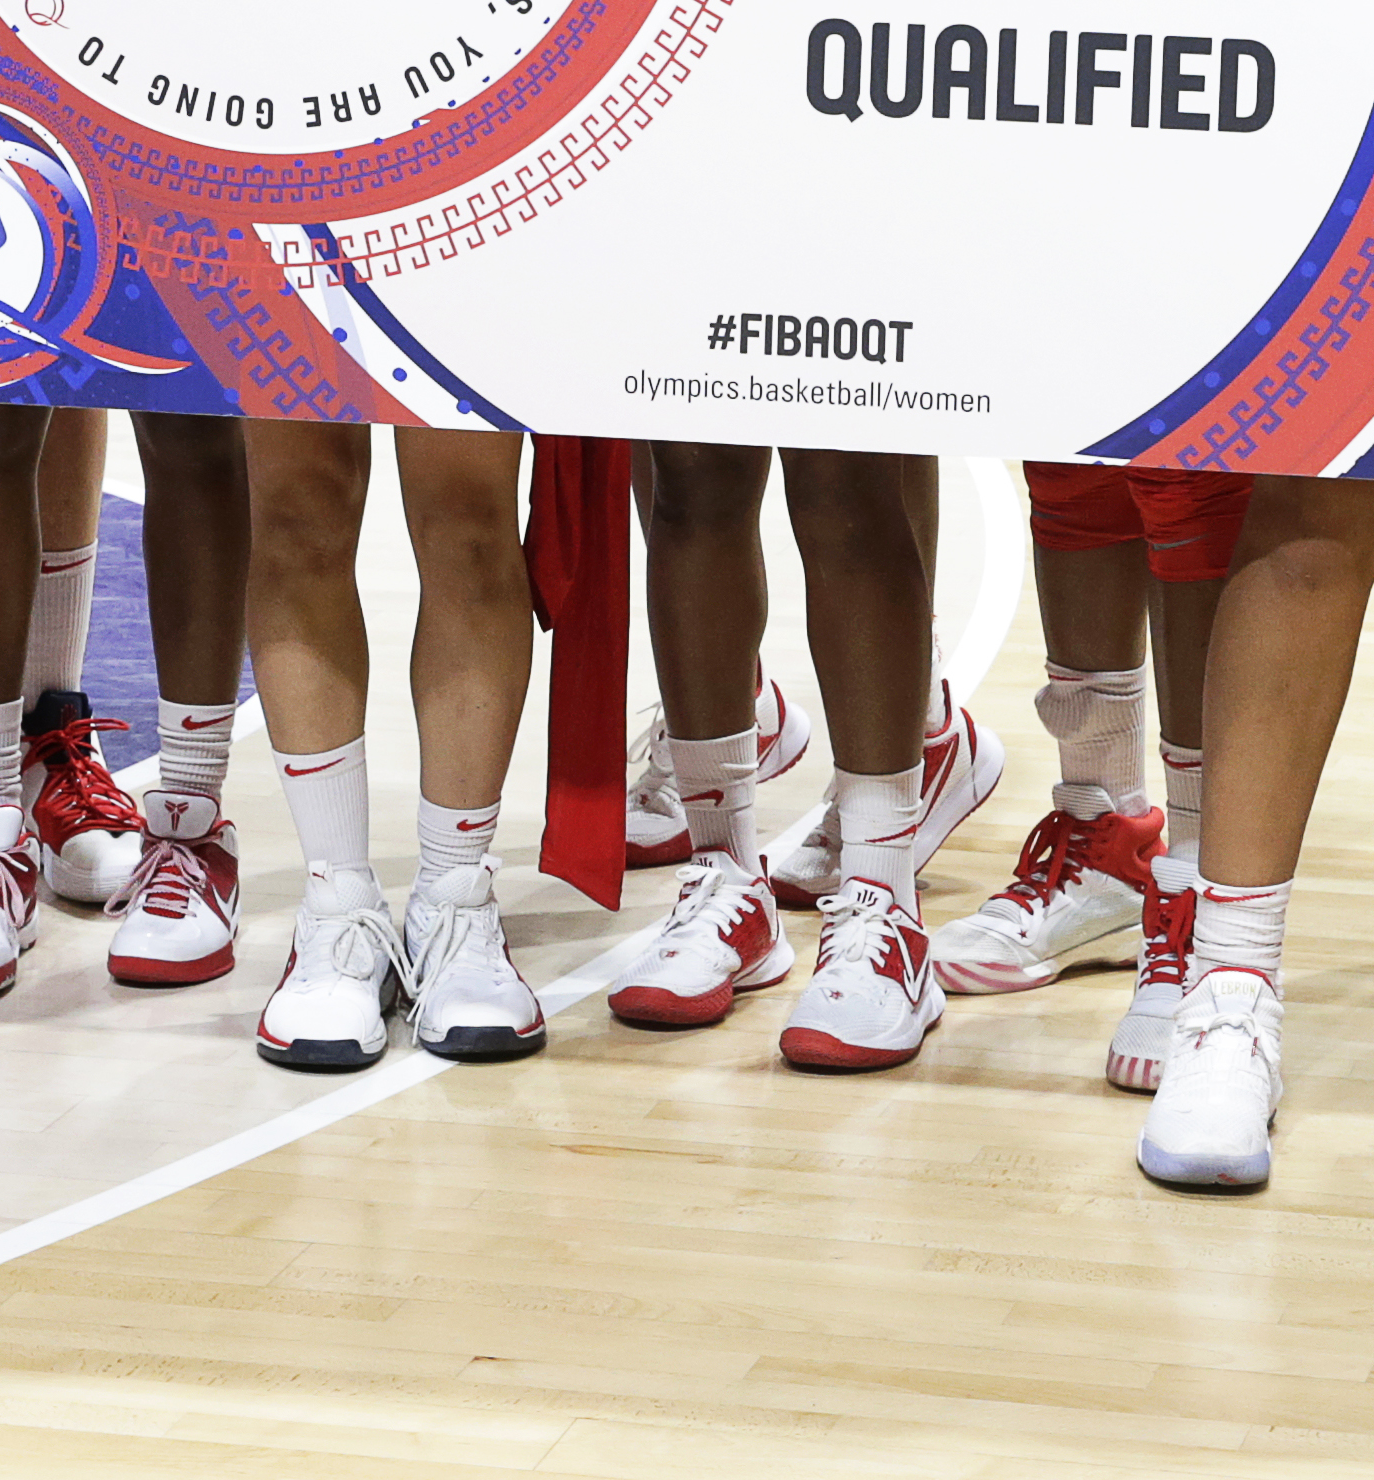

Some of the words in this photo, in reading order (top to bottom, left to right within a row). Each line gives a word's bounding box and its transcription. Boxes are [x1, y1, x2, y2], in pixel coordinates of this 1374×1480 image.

[79, 37, 124, 85] TO
[405, 37, 483, 98] YOU
[807, 19, 1275, 132] QUALIFIED
[148, 75, 273, 129] GOING
[303, 84, 381, 127] ARE
[708, 314, 913, 364] #FIBAOQT
[625, 370, 990, 412] olympics.basketball/women
